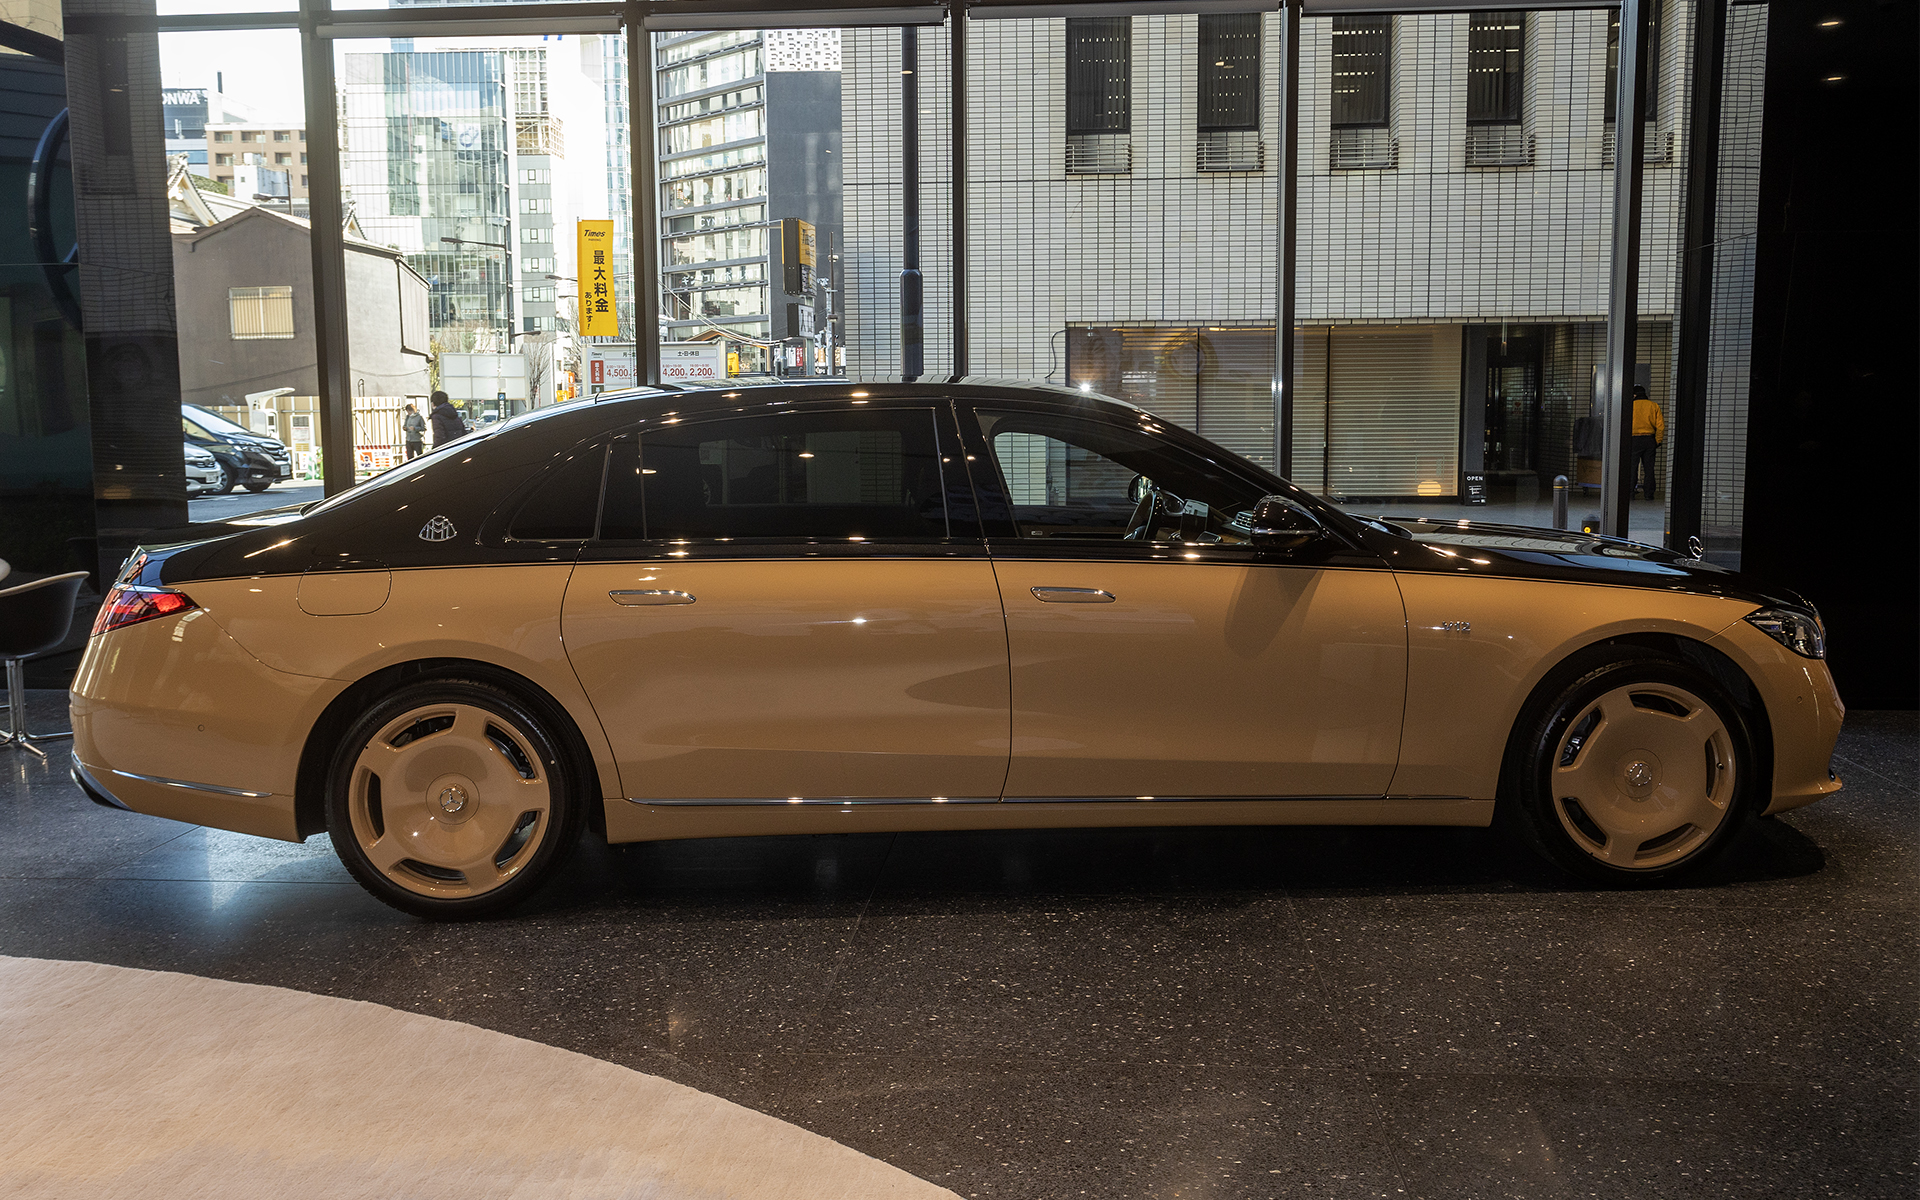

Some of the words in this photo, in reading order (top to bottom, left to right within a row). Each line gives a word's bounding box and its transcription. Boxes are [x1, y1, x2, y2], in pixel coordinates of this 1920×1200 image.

[700, 215, 740, 227] CYNTHIA
[584, 229, 606, 237] Times
[593, 250, 609, 313] 最大料金
[1442, 620, 1471, 631] V12
